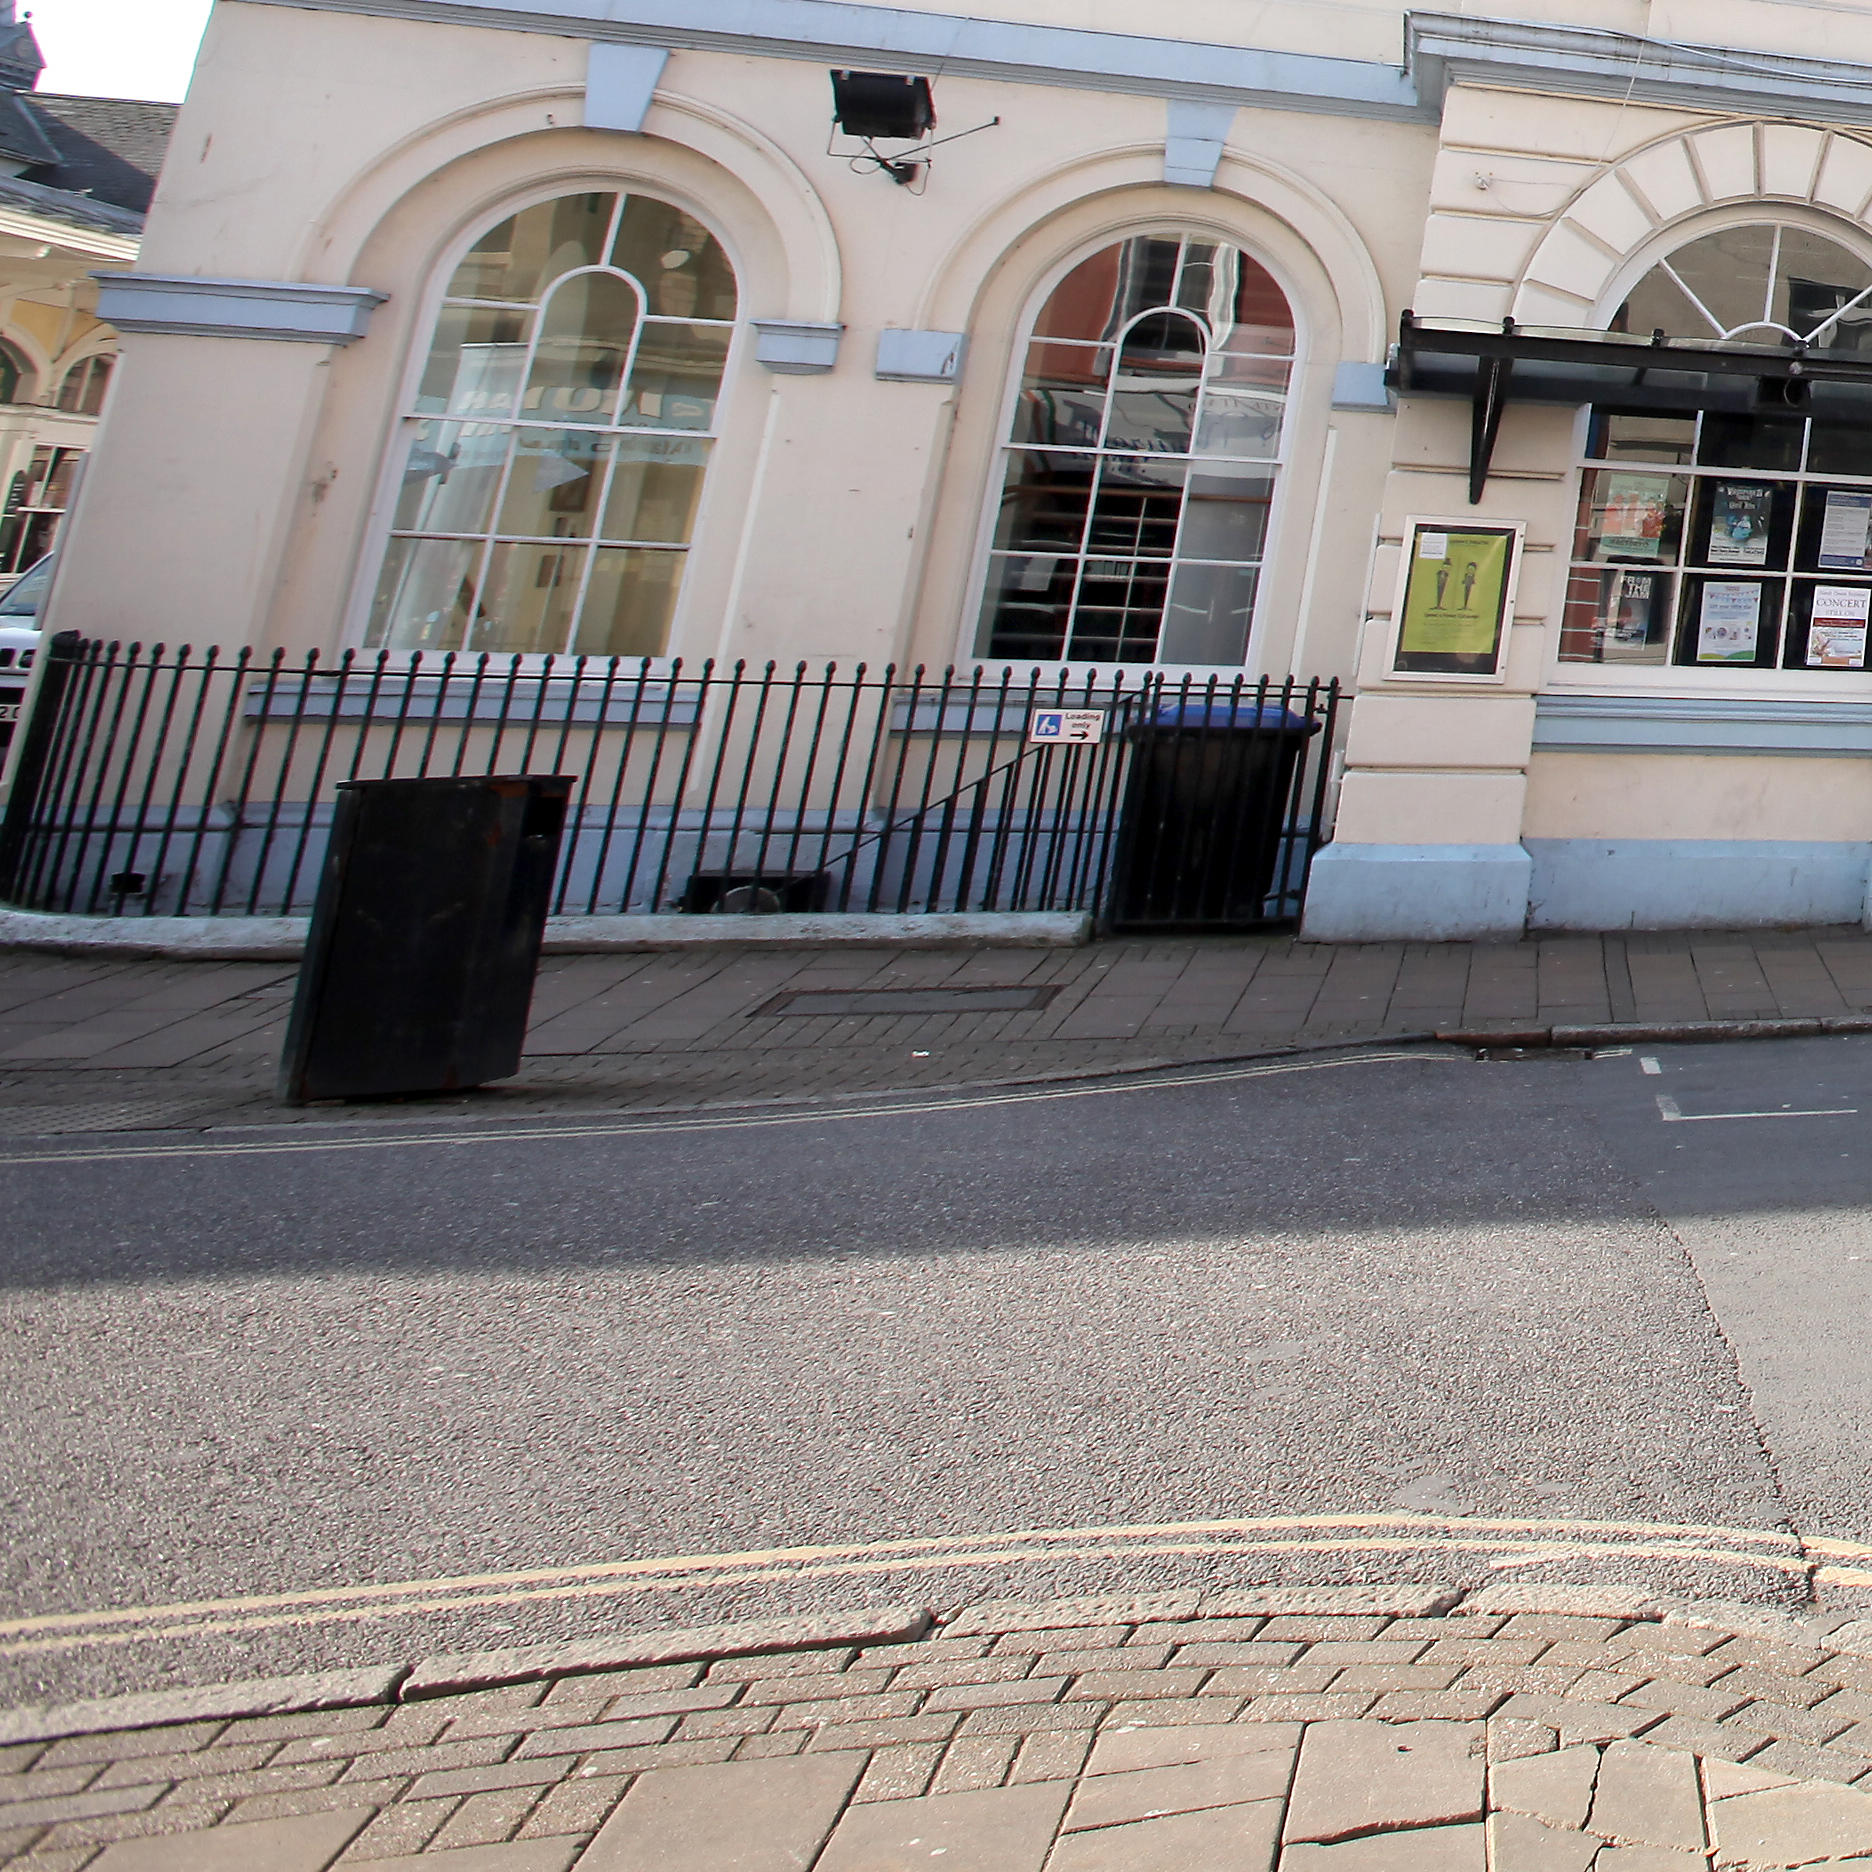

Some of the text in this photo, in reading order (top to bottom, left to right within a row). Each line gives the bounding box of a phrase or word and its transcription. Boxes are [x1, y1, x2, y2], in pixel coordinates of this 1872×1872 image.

[1621, 576, 1651, 584] FROM
[1629, 584, 1650, 593] THE
[1816, 599, 1866, 608] CONCERT
[1065, 713, 1101, 721] Loading
